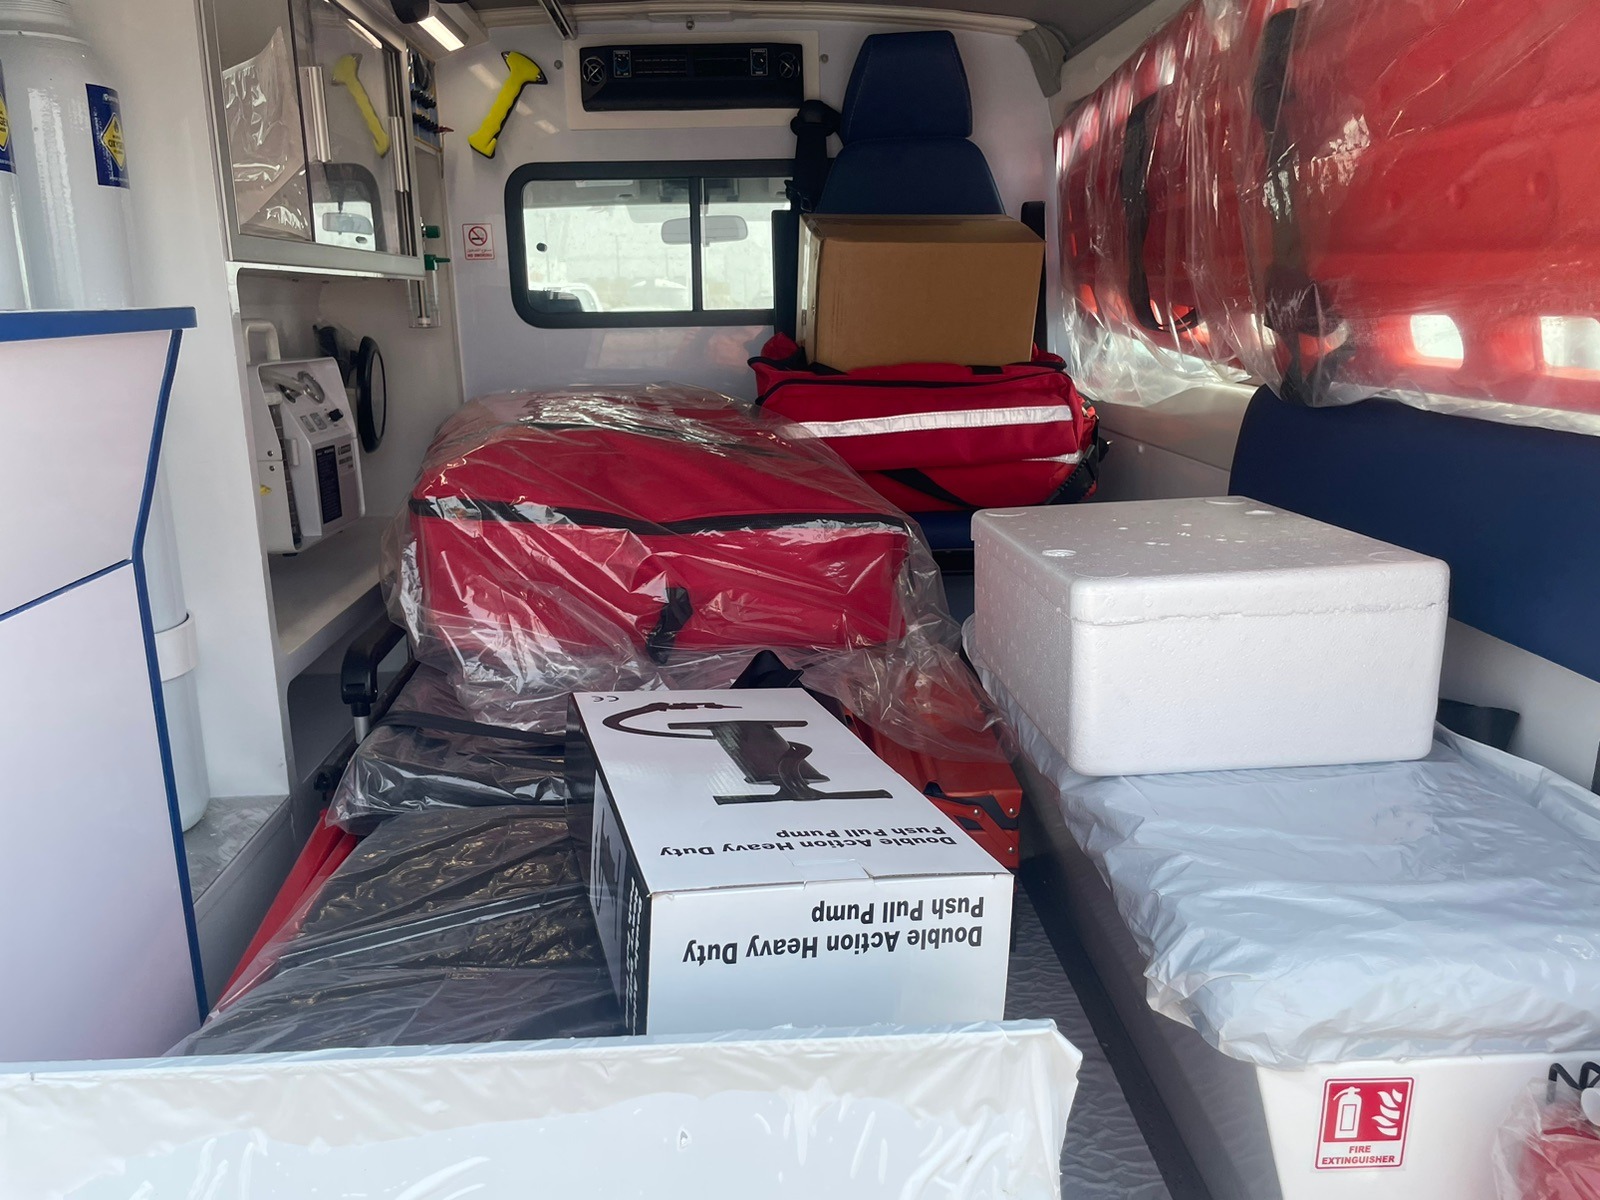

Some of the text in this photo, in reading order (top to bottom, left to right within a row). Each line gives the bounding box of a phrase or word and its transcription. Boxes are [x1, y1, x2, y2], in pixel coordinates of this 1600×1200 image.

[776, 826, 947, 839] Push Pull Pump
[660, 837, 957, 857] Double Action Heavy Duty
[811, 897, 984, 924] Push Pull Pump
[682, 926, 983, 967] Double Action Heavy Duty
[1349, 1145, 1371, 1154] FIRE
[1322, 1155, 1395, 1165] EXTINGUISHER
